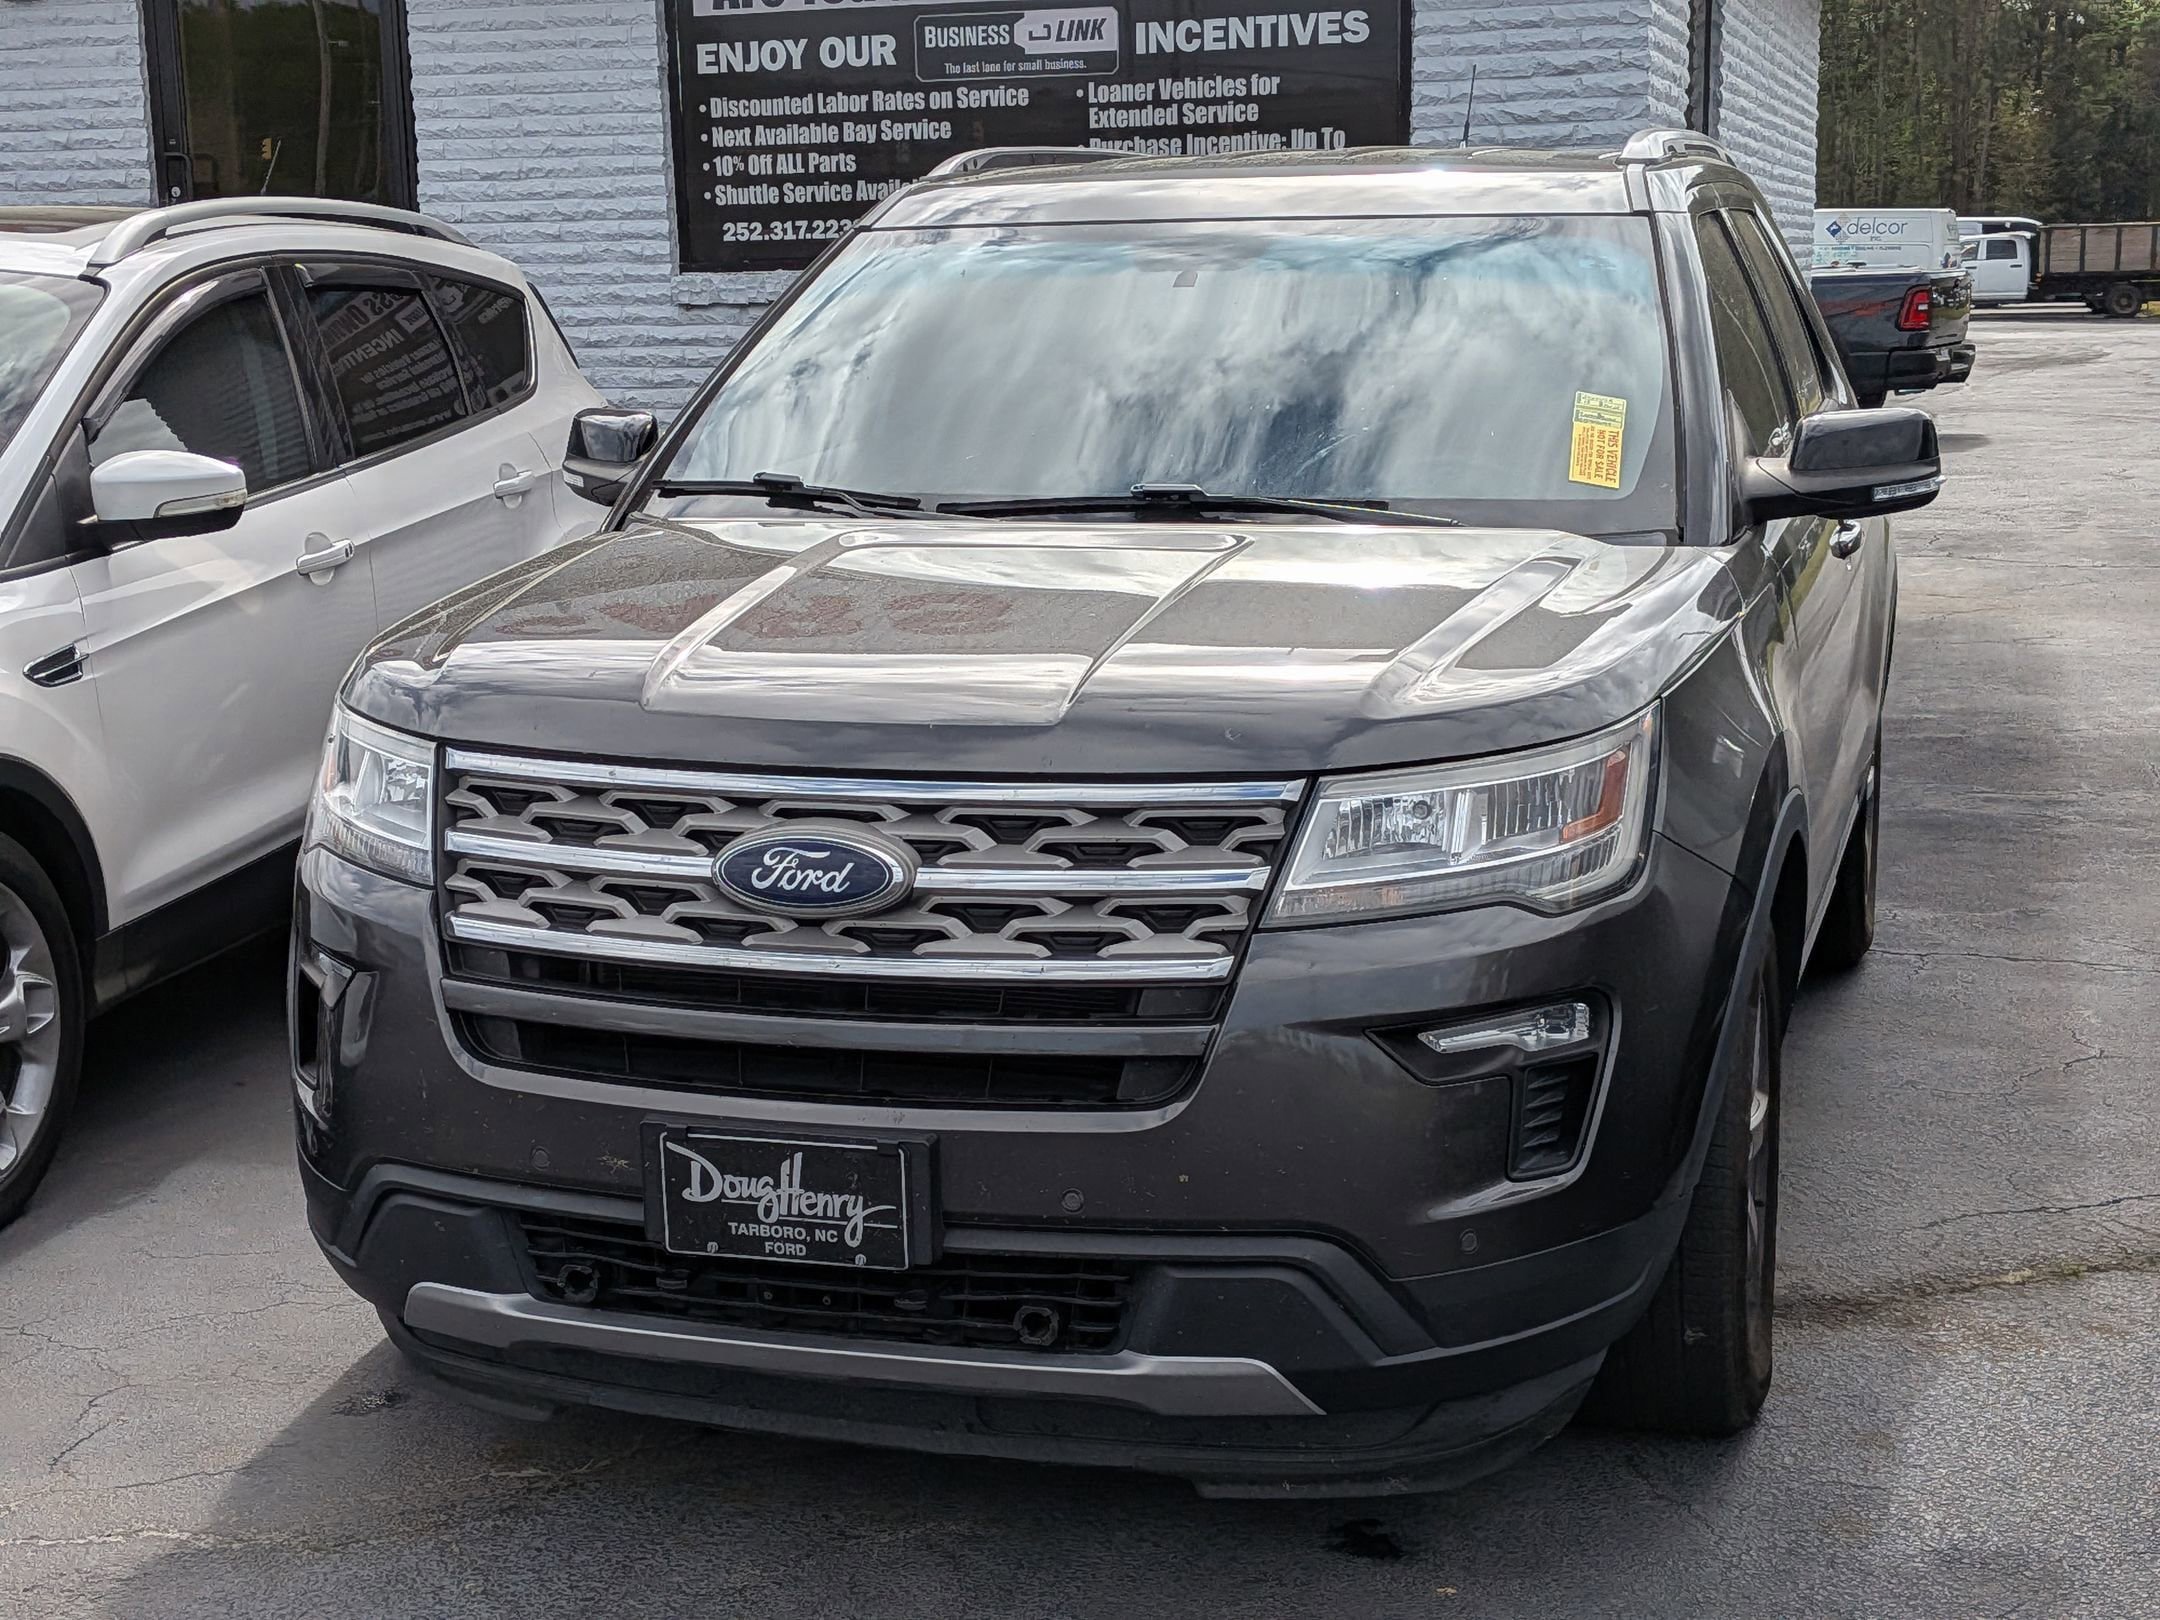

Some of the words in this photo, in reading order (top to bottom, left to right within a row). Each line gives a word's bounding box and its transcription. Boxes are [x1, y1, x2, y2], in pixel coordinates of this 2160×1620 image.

[924, 24, 1010, 49] BUSINESS
[1055, 17, 1107, 42] LINK
[1135, 10, 1370, 55] INCENTIVES
[696, 38, 808, 75] ENJOY
[819, 34, 897, 69] OUR
[1003, 60, 1016, 72] for
[1019, 59, 1042, 72] small
[710, 93, 814, 119] Discounted
[817, 91, 869, 114] Labor
[872, 90, 926, 112] Rates
[929, 90, 953, 110] on
[956, 85, 1030, 109] Service
[1088, 81, 1155, 104] Loaner
[1158, 75, 1247, 100] Vehicles
[1250, 73, 1280, 96] for
[1089, 103, 1178, 129] Extended
[1182, 100, 1259, 125] Service
[711, 126, 752, 148] Next
[754, 123, 839, 147] Available
[843, 121, 877, 144] Bay
[880, 118, 952, 141] Service
[1186, 130, 1287, 156] Incentive:
[1321, 126, 1346, 150] To
[713, 154, 745, 177] 10%
[748, 154, 773, 176] Off
[776, 153, 805, 175] ALL
[808, 152, 857, 173] Parts
[714, 183, 779, 206] Shuttle
[783, 181, 852, 204] Service
[722, 218, 861, 242] 252.317.223
[1846, 216, 1909, 235] delcor
[1605, 449, 1618, 484] VEHICLE
[751, 846, 855, 893] Ford
[728, 1222, 811, 1243] TARBORO,
[815, 1229, 838, 1243] NC
[764, 1241, 807, 1257] FORD
